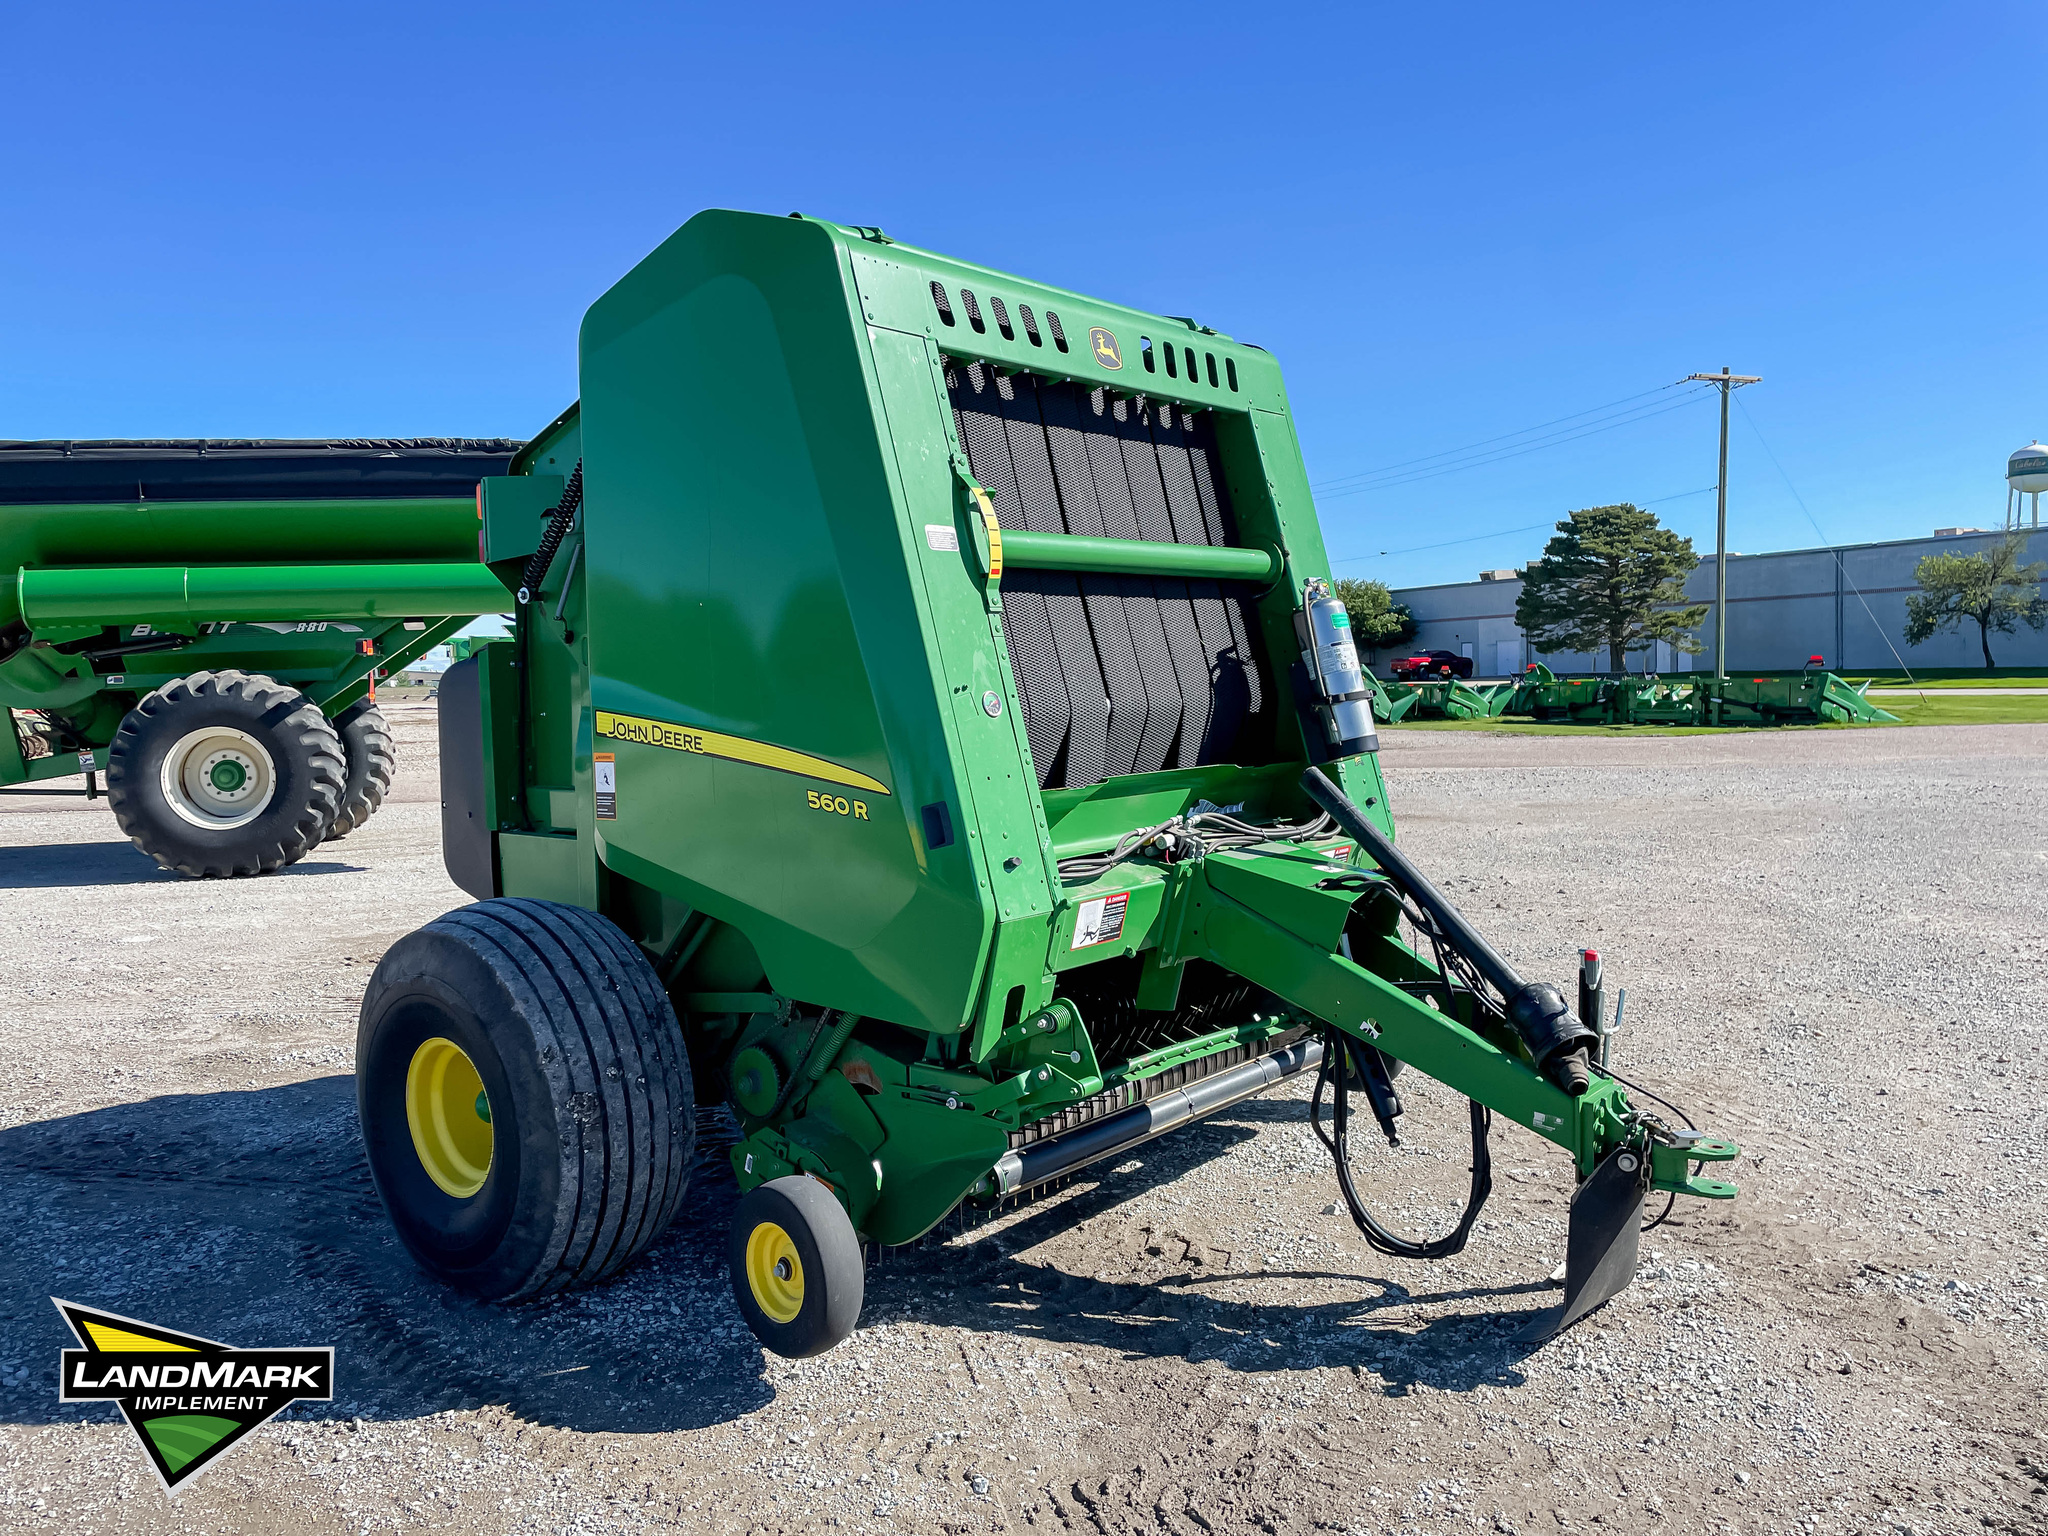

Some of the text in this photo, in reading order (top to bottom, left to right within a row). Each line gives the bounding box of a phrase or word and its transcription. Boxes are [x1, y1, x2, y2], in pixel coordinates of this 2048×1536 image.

[296, 622, 328, 633] 880
[608, 718, 704, 751] JOHN DEERE
[807, 790, 871, 821] 560 R
